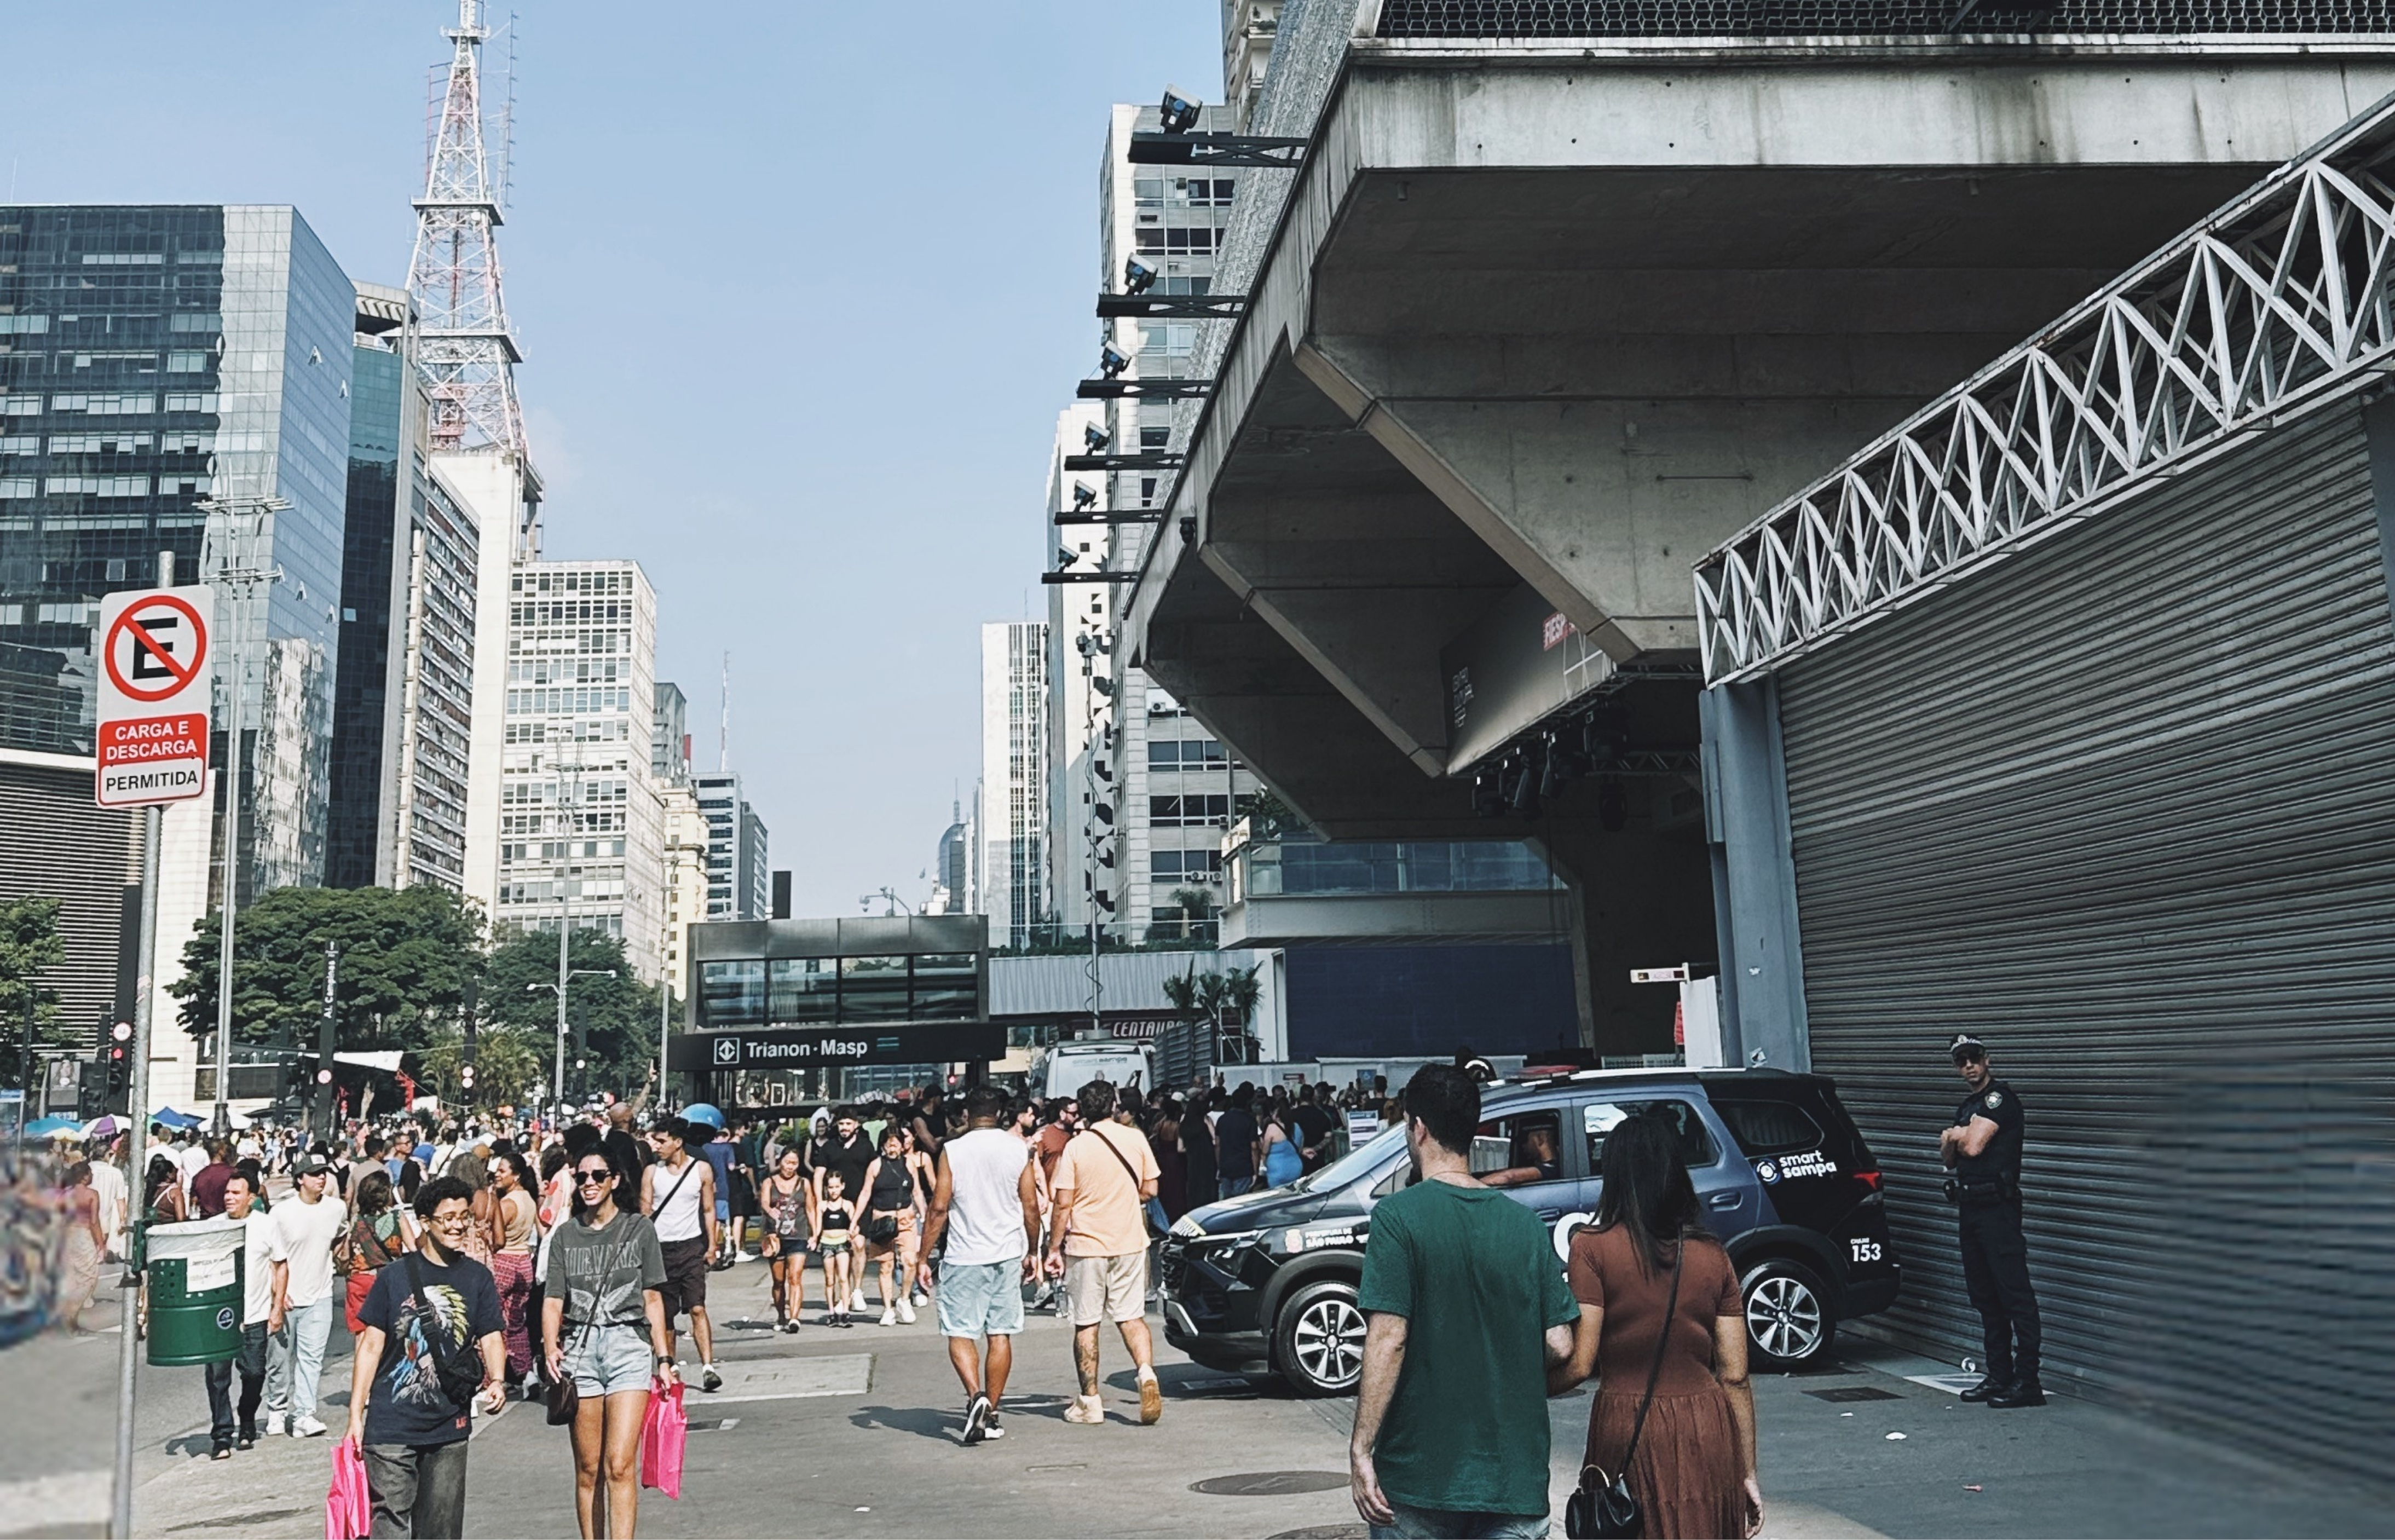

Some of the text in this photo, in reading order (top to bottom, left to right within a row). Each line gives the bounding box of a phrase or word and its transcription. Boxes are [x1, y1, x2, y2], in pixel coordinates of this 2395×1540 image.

[132, 617, 178, 680] E
[115, 721, 189, 741] CARGA E
[106, 739, 197, 760] DESCARGA
[106, 770, 198, 792] PERMITIDA
[746, 1041, 810, 1058] Trianon
[821, 1039, 868, 1058] Masp
[1779, 1150, 1824, 1167] smart
[1783, 1161, 1837, 1179] sampa
[1325, 1235, 1354, 1246] PAULO
[1852, 1243, 1882, 1262] 153
